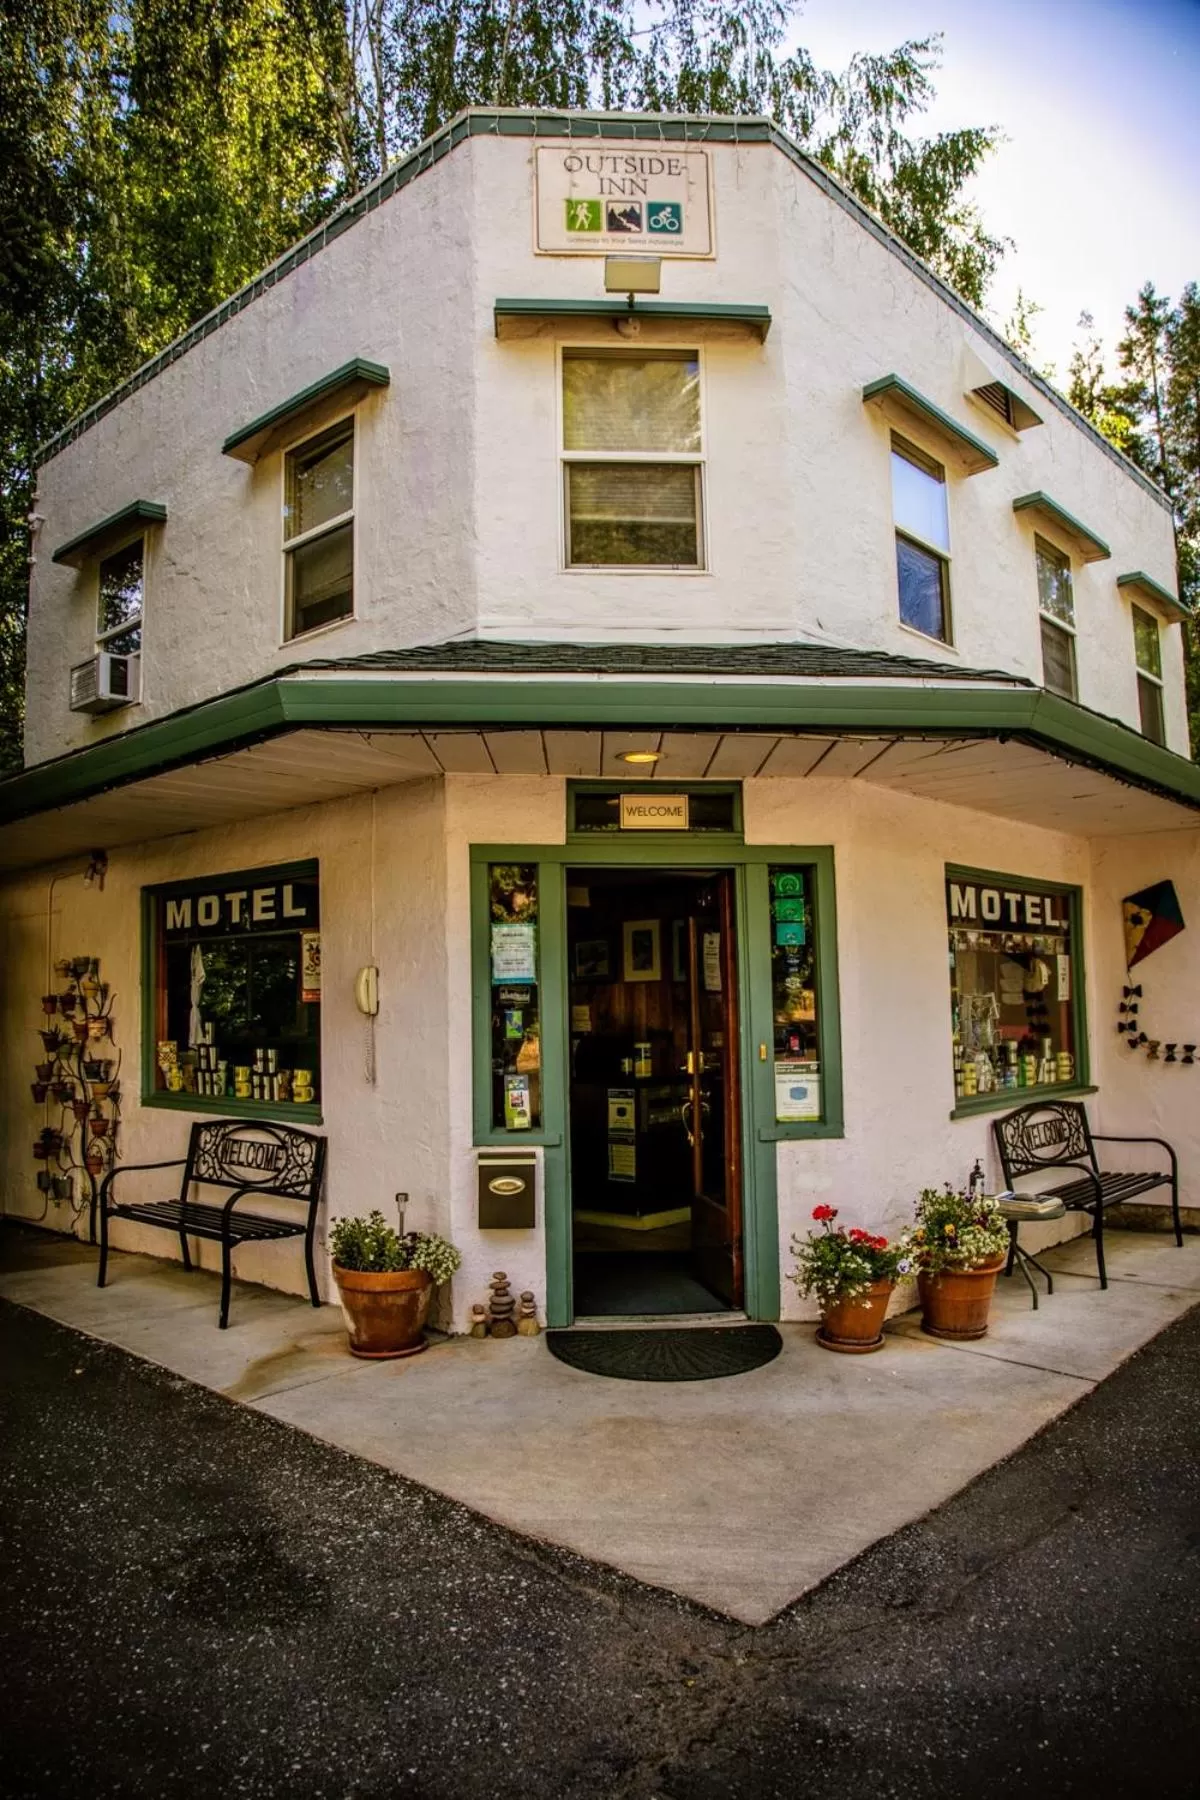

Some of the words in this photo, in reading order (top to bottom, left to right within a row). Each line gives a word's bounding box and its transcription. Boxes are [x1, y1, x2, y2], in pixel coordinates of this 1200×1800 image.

[563, 155, 682, 176] OUTSIDE
[599, 176, 649, 196] INN
[626, 805, 684, 817] WELCOME
[165, 884, 307, 930] MOTEL
[949, 884, 1061, 927] MOTEL
[1022, 1119, 1069, 1152] WELCOME
[221, 1139, 285, 1171] WELCOME
